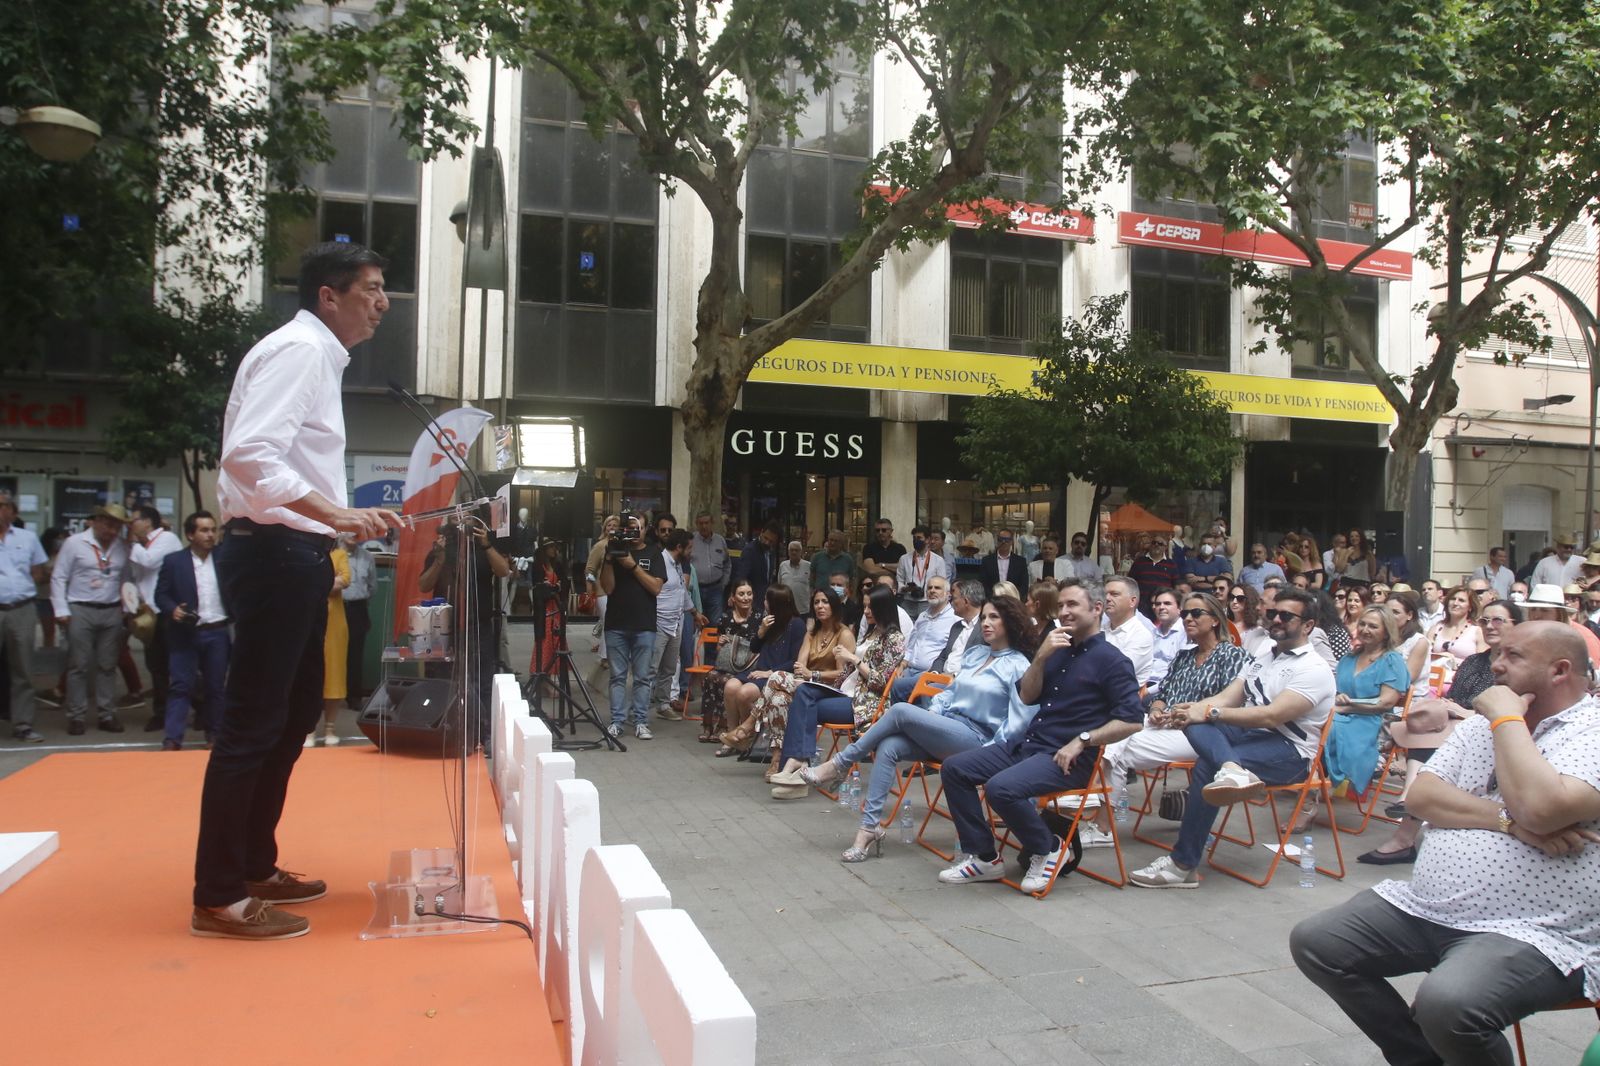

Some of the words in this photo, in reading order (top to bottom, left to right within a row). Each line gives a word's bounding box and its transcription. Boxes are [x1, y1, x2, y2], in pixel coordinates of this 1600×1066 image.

[1156, 223, 1200, 241] CEPSA
[832, 361, 853, 375] DE
[857, 363, 896, 378] VIDA
[900, 366, 910, 379] Y
[915, 367, 997, 384] PENSIONES
[1208, 388, 1261, 403] EGUROS
[1265, 393, 1281, 406] DE
[1284, 394, 1312, 408] VIDA
[1314, 397, 1321, 408] Y
[1325, 398, 1387, 413] PENSIONES
[436, 427, 467, 458] Cs
[731, 429, 864, 460] GUESS
